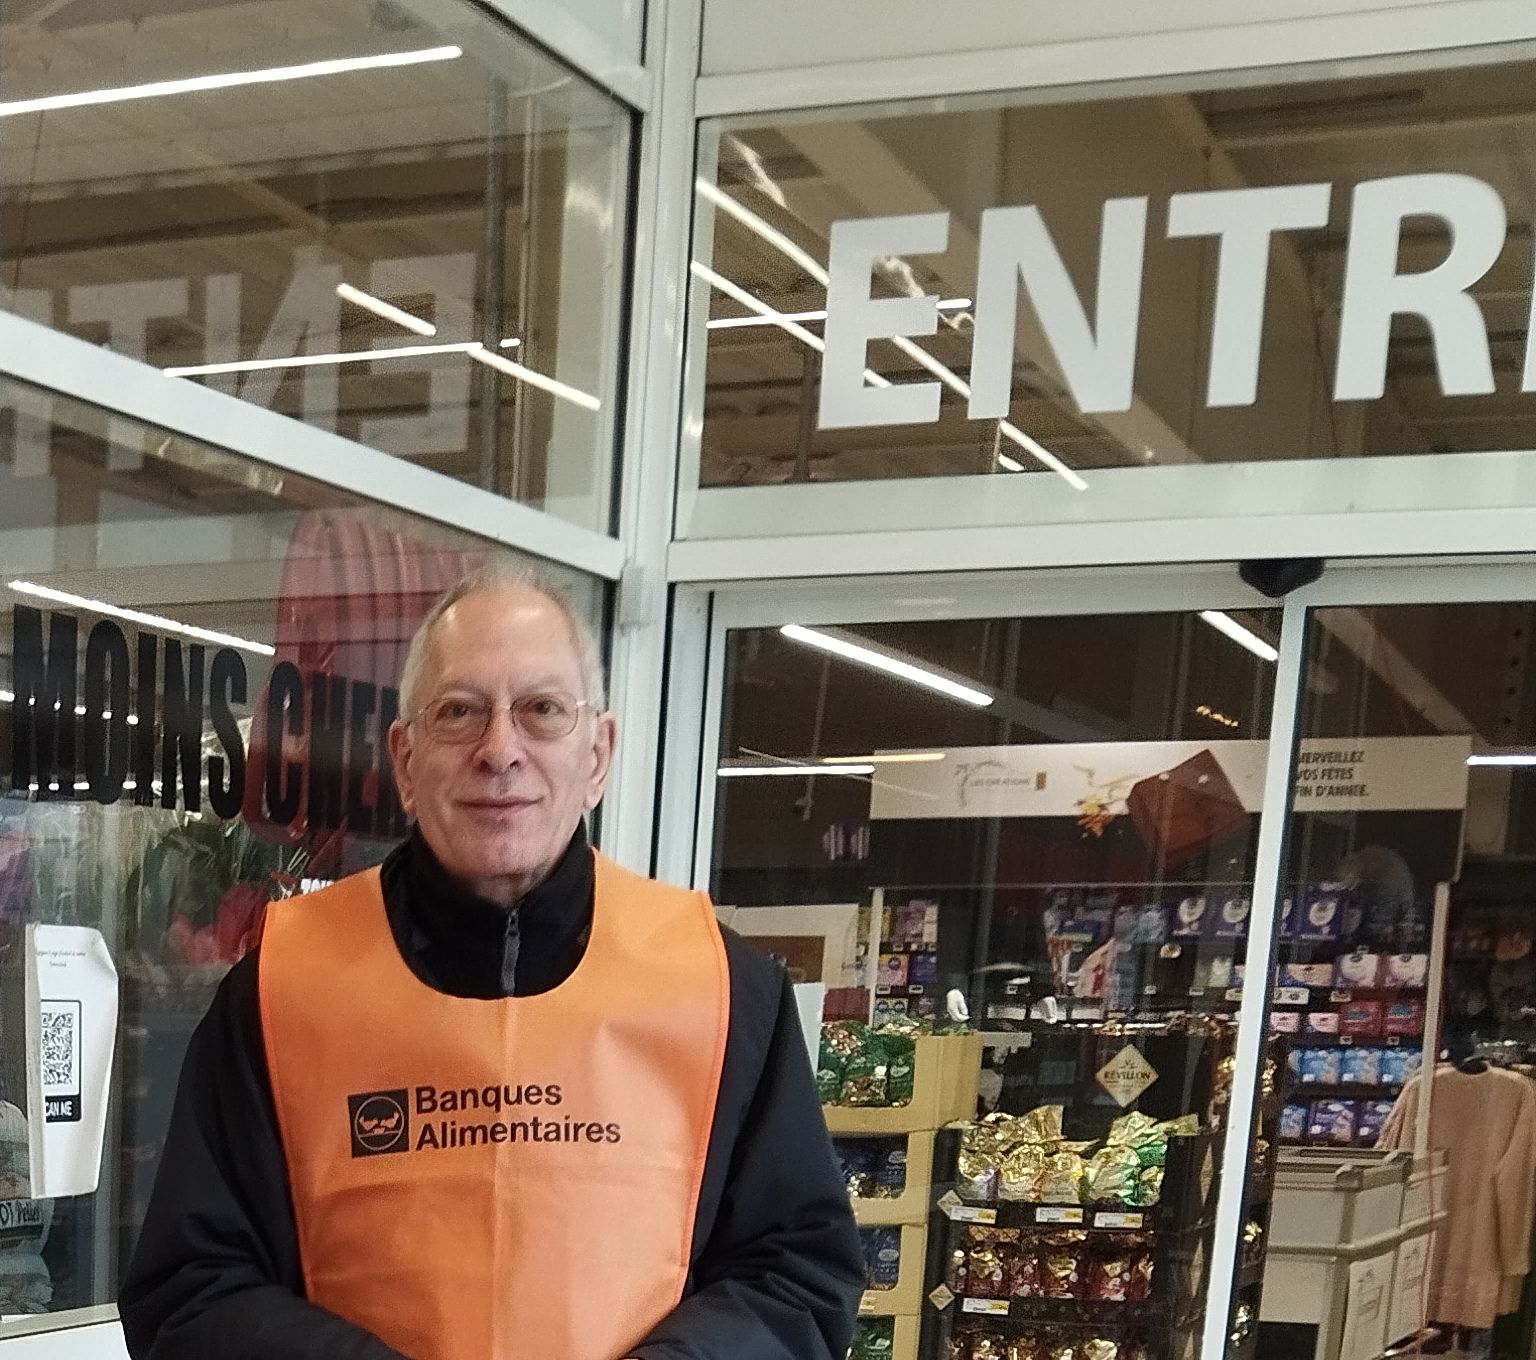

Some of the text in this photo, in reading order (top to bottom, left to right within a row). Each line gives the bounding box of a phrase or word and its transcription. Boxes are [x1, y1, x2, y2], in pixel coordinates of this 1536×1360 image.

[817, 171, 1536, 430] ENTR
[12, 603, 248, 820] MOINS
[416, 1084, 563, 1115] Banques
[416, 1115, 622, 1151] Alimentaires
